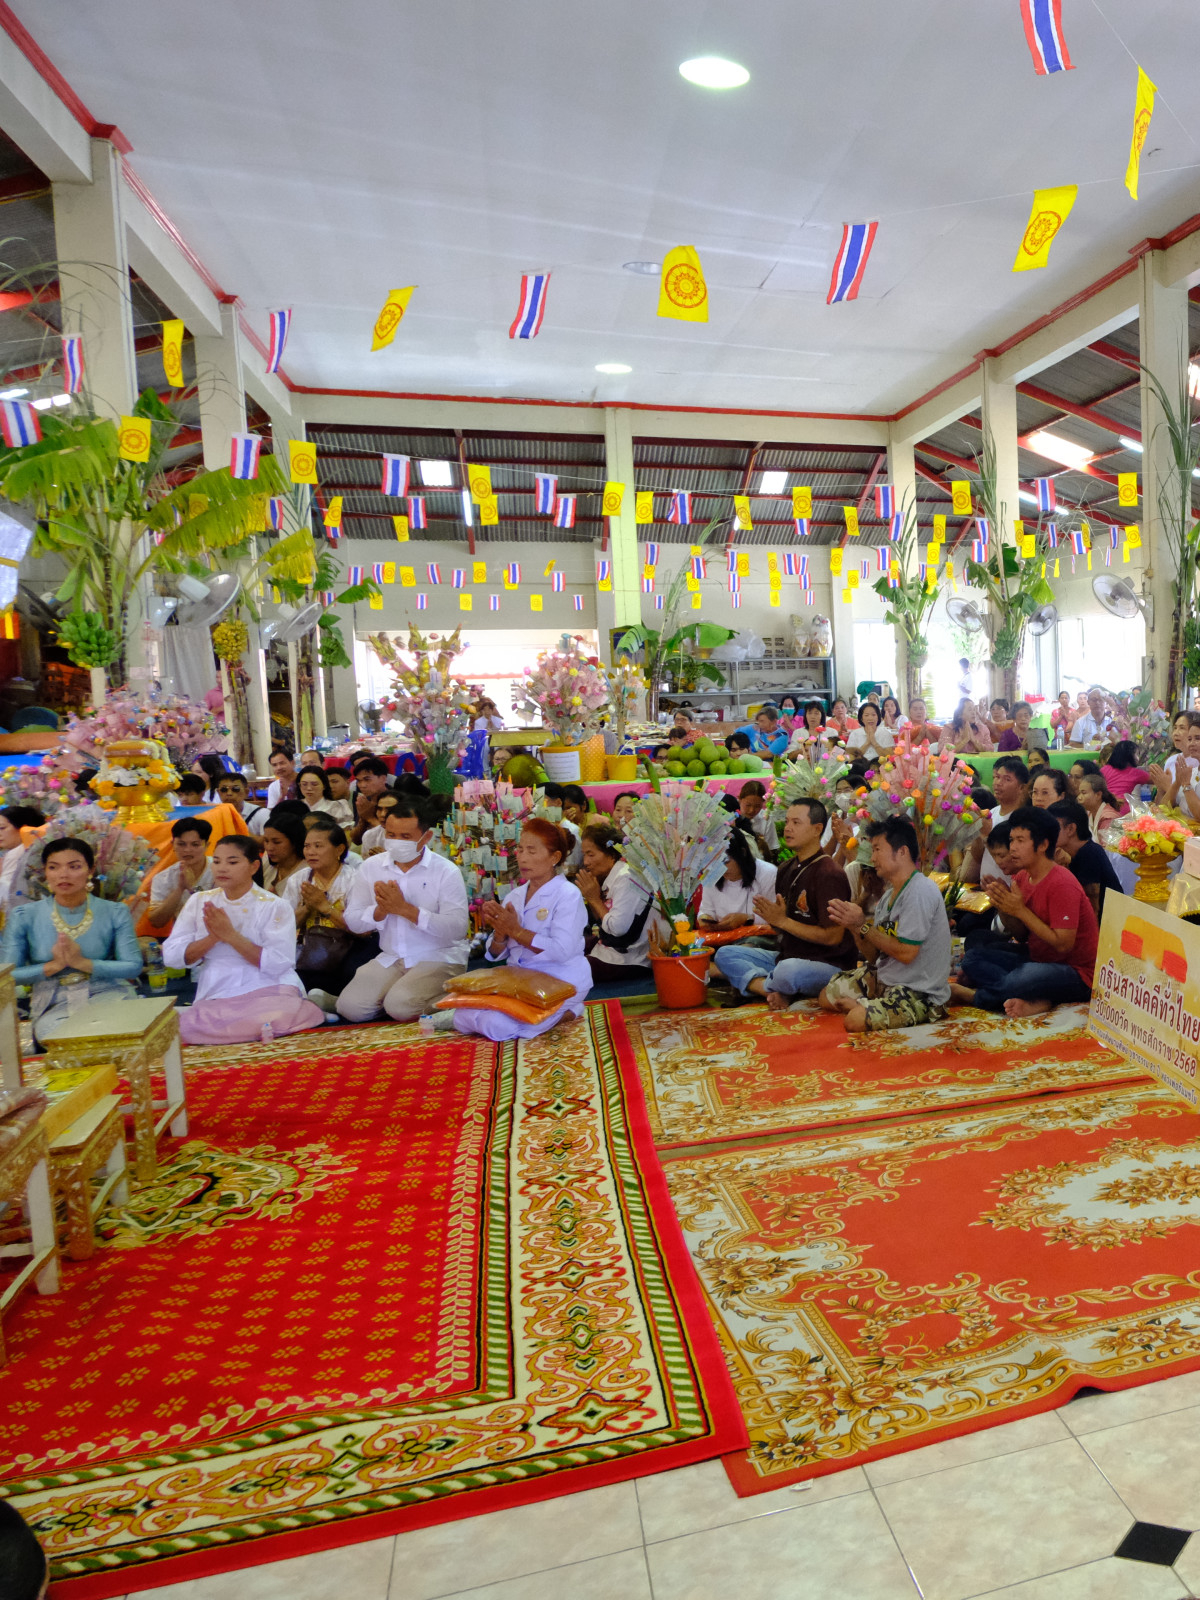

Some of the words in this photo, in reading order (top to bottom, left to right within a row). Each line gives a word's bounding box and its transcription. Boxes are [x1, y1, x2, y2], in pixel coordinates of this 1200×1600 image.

[1100, 959, 1200, 1042] กฐินสามัคคีทั่วไทย
[1174, 1049, 1197, 1078] 2568
